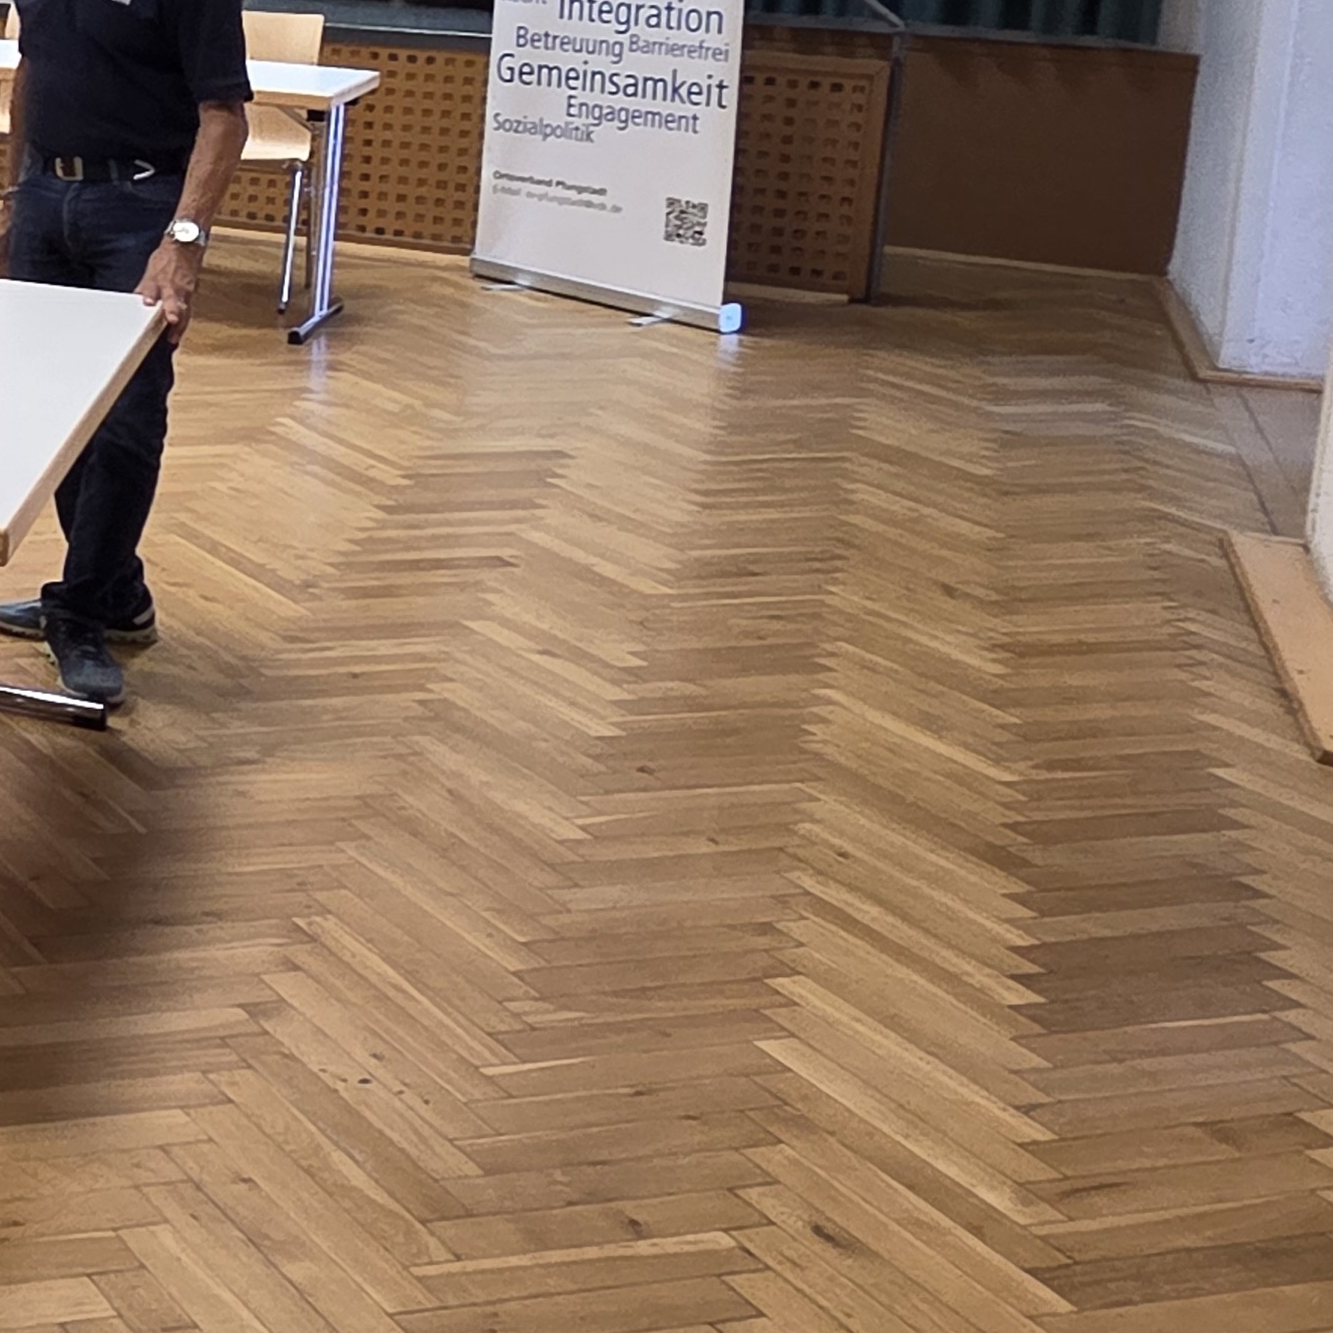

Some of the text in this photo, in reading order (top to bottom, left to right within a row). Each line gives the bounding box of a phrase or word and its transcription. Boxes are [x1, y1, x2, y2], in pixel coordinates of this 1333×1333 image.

[515, 26, 624, 64] Betreuung
[628, 34, 730, 63] Barrierefrei
[496, 53, 729, 109] Gemeinsamkeit
[492, 113, 595, 143] Sozialpolitik
[566, 95, 700, 134] Engagement
